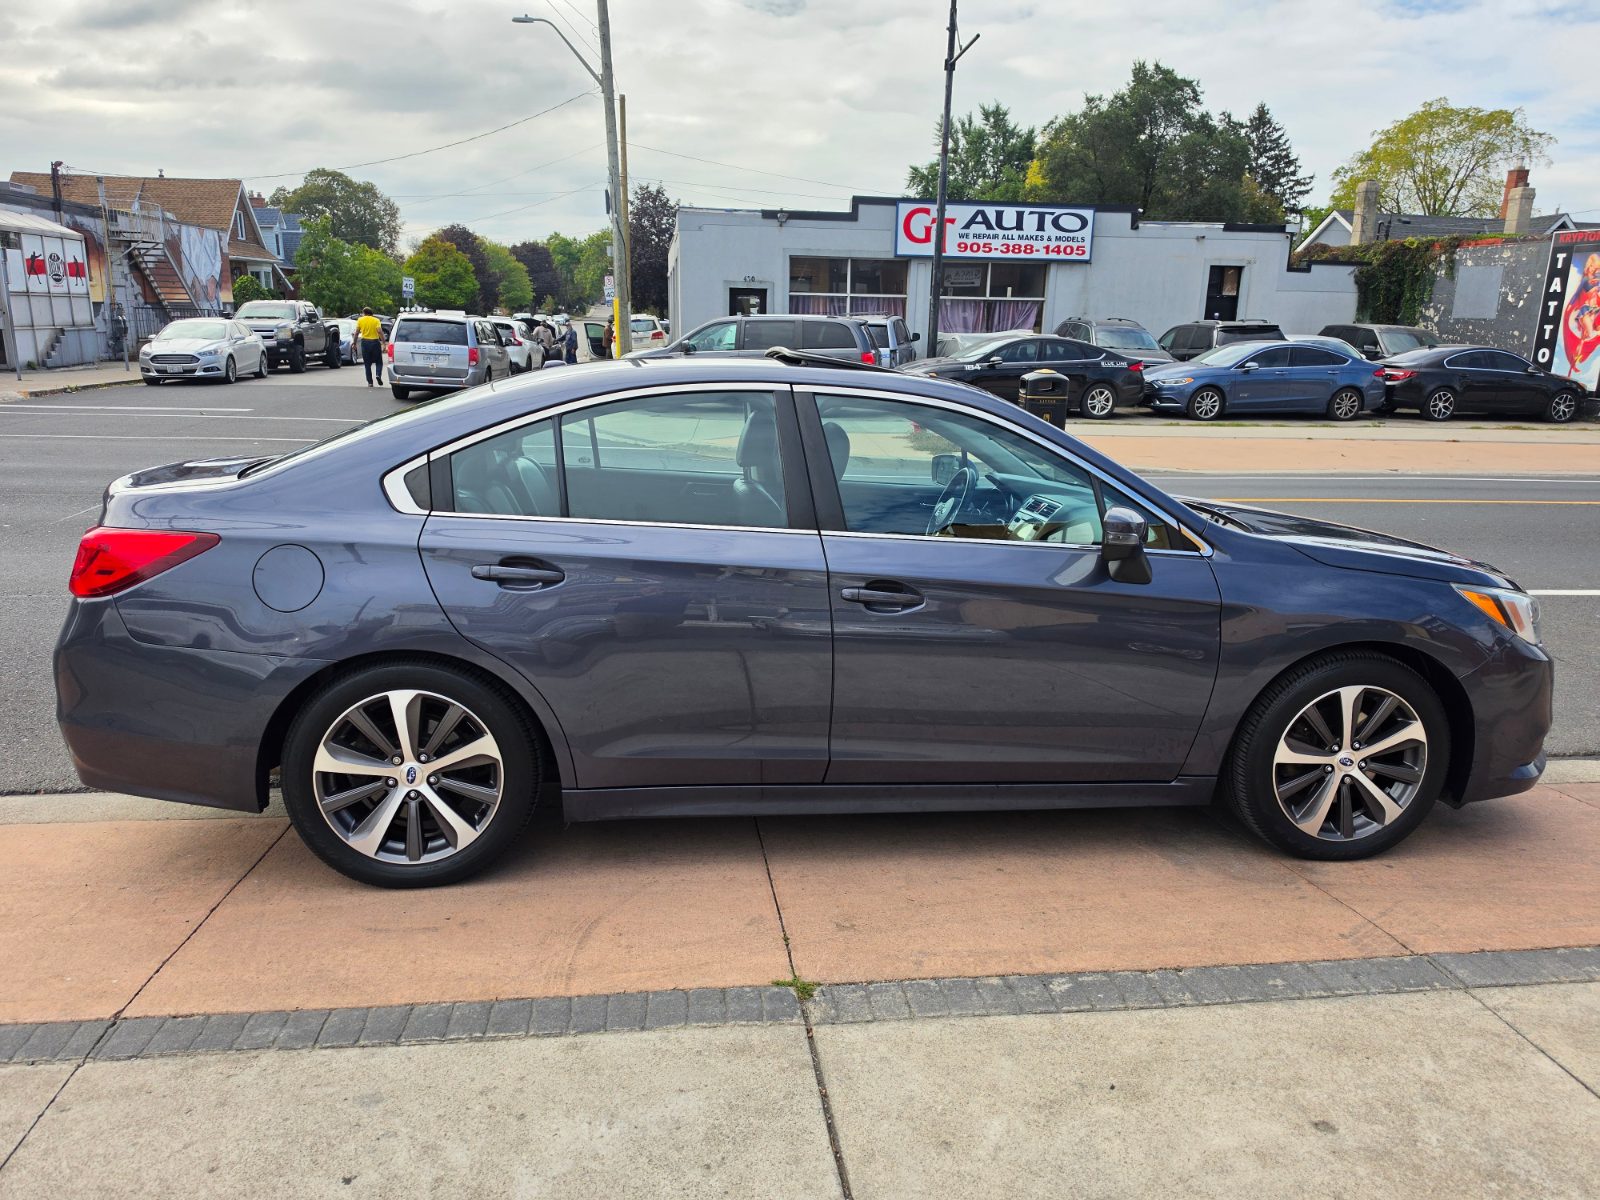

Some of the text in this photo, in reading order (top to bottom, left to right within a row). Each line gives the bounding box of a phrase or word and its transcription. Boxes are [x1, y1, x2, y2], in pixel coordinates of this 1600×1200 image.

[902, 207, 1089, 254] GT AUTO
[958, 232, 970, 240] WE
[972, 233, 999, 241] REPAIR
[1017, 234, 1045, 242] MAKES
[1055, 235, 1086, 243] MODELS
[957, 241, 1087, 256] 905-388-1405
